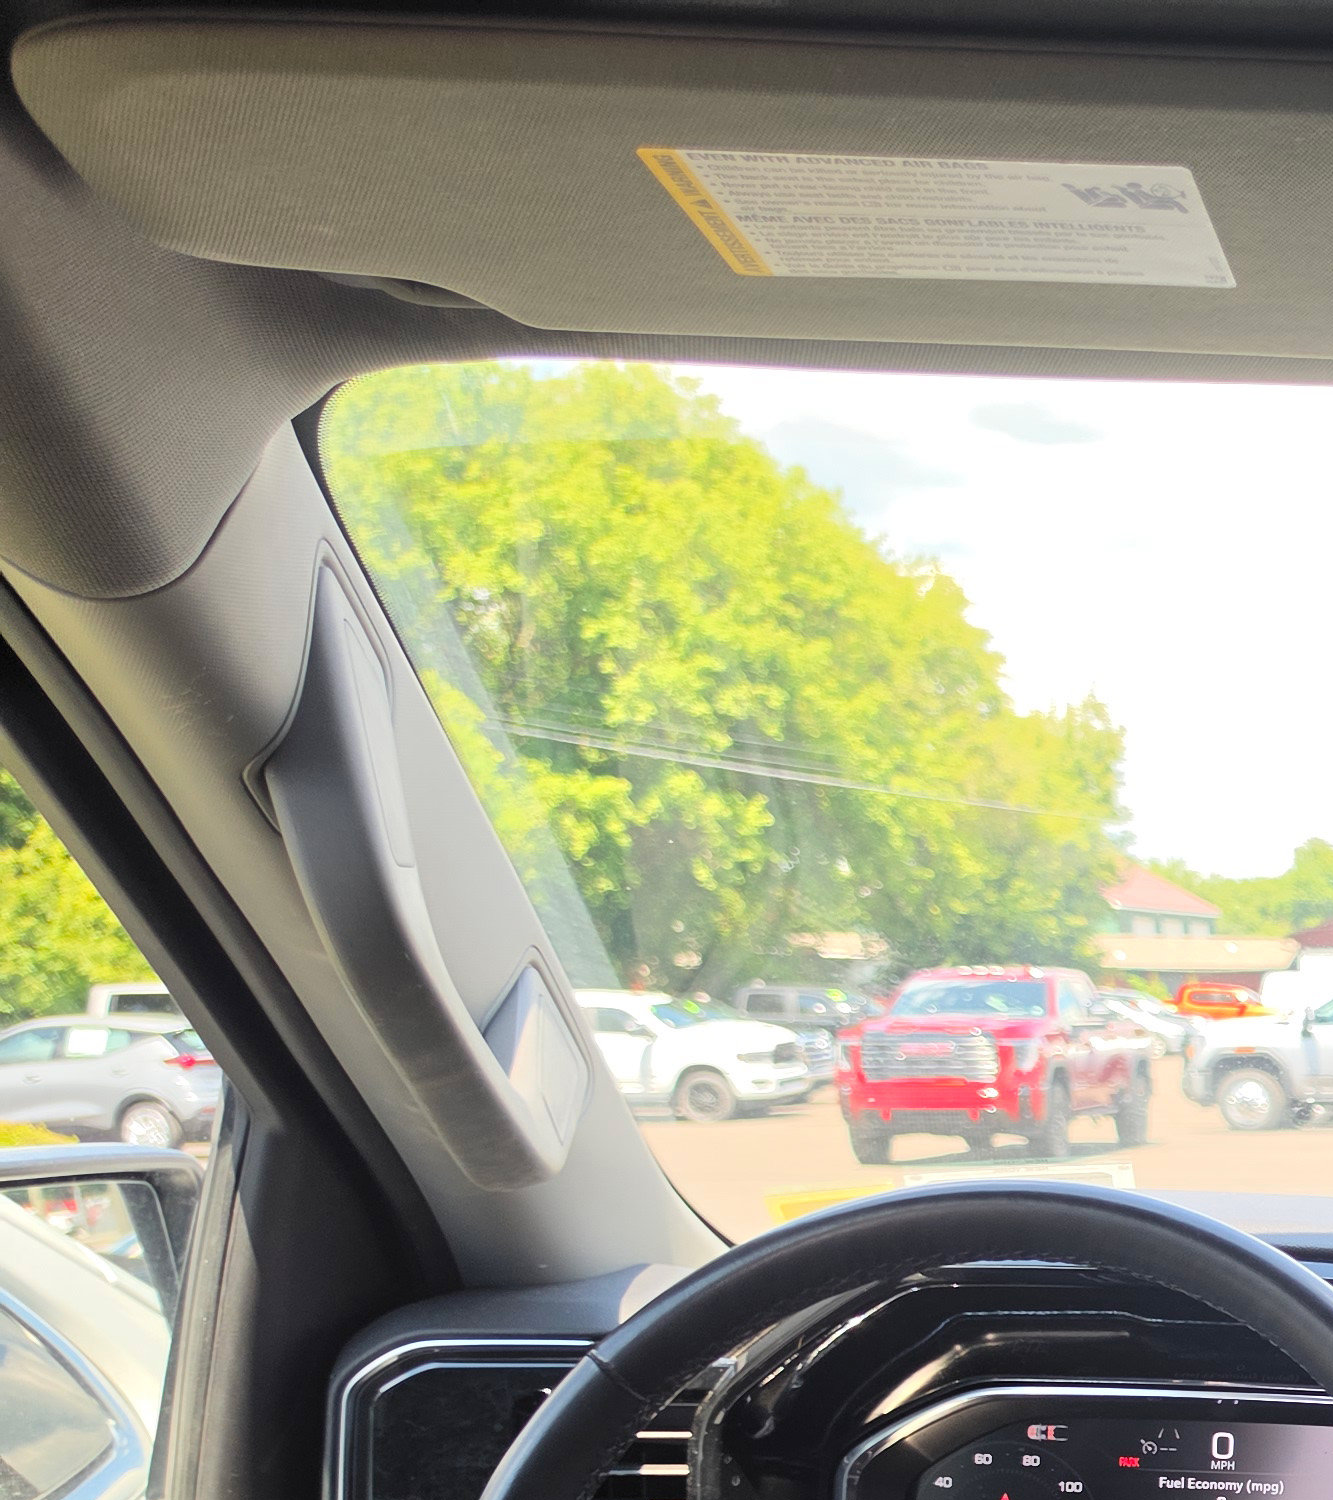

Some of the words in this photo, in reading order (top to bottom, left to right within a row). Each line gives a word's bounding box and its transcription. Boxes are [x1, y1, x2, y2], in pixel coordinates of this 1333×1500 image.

[686, 152, 736, 162] EVEN
[739, 154, 789, 164] WITH
[795, 156, 896, 167] ADVANCED
[902, 159, 934, 169] AIR
[937, 161, 988, 171] BAGS
[1211, 1431, 1235, 1461] 0
[1022, 1454, 1041, 1467] 80
[1211, 1459, 1235, 1471] MPH
[933, 1476, 953, 1488] 40
[1058, 1481, 1083, 1493] 100
[1158, 1476, 1185, 1490] Fuel
[1187, 1478, 1244, 1494] Economy
[1246, 1479, 1285, 1496] (mpg)
